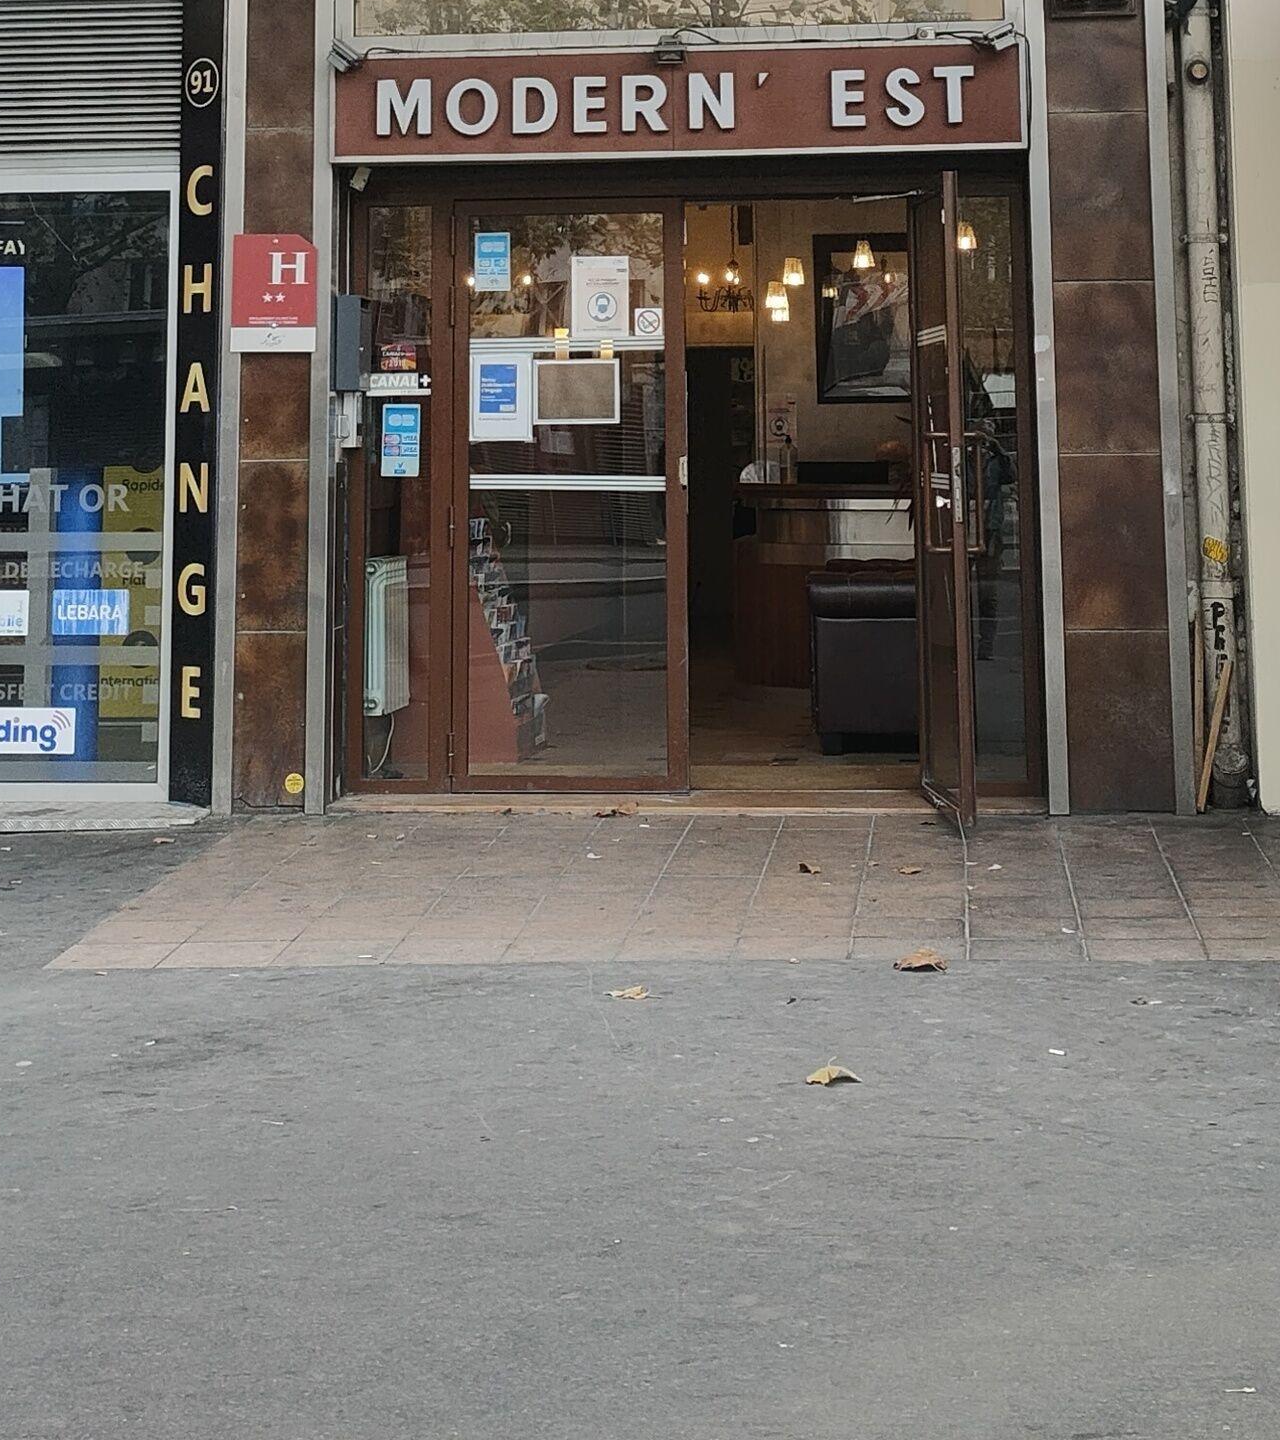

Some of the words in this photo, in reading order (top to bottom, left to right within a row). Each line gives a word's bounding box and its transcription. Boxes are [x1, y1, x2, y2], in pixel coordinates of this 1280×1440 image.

[190, 69, 214, 95] 91
[830, 64, 976, 128] EST
[267, 251, 310, 285] H
[178, 165, 214, 719] CHANGE
[79, 483, 131, 512] OR
[49, 560, 145, 578] ECHARGE
[57, 604, 123, 621] LEBARA
